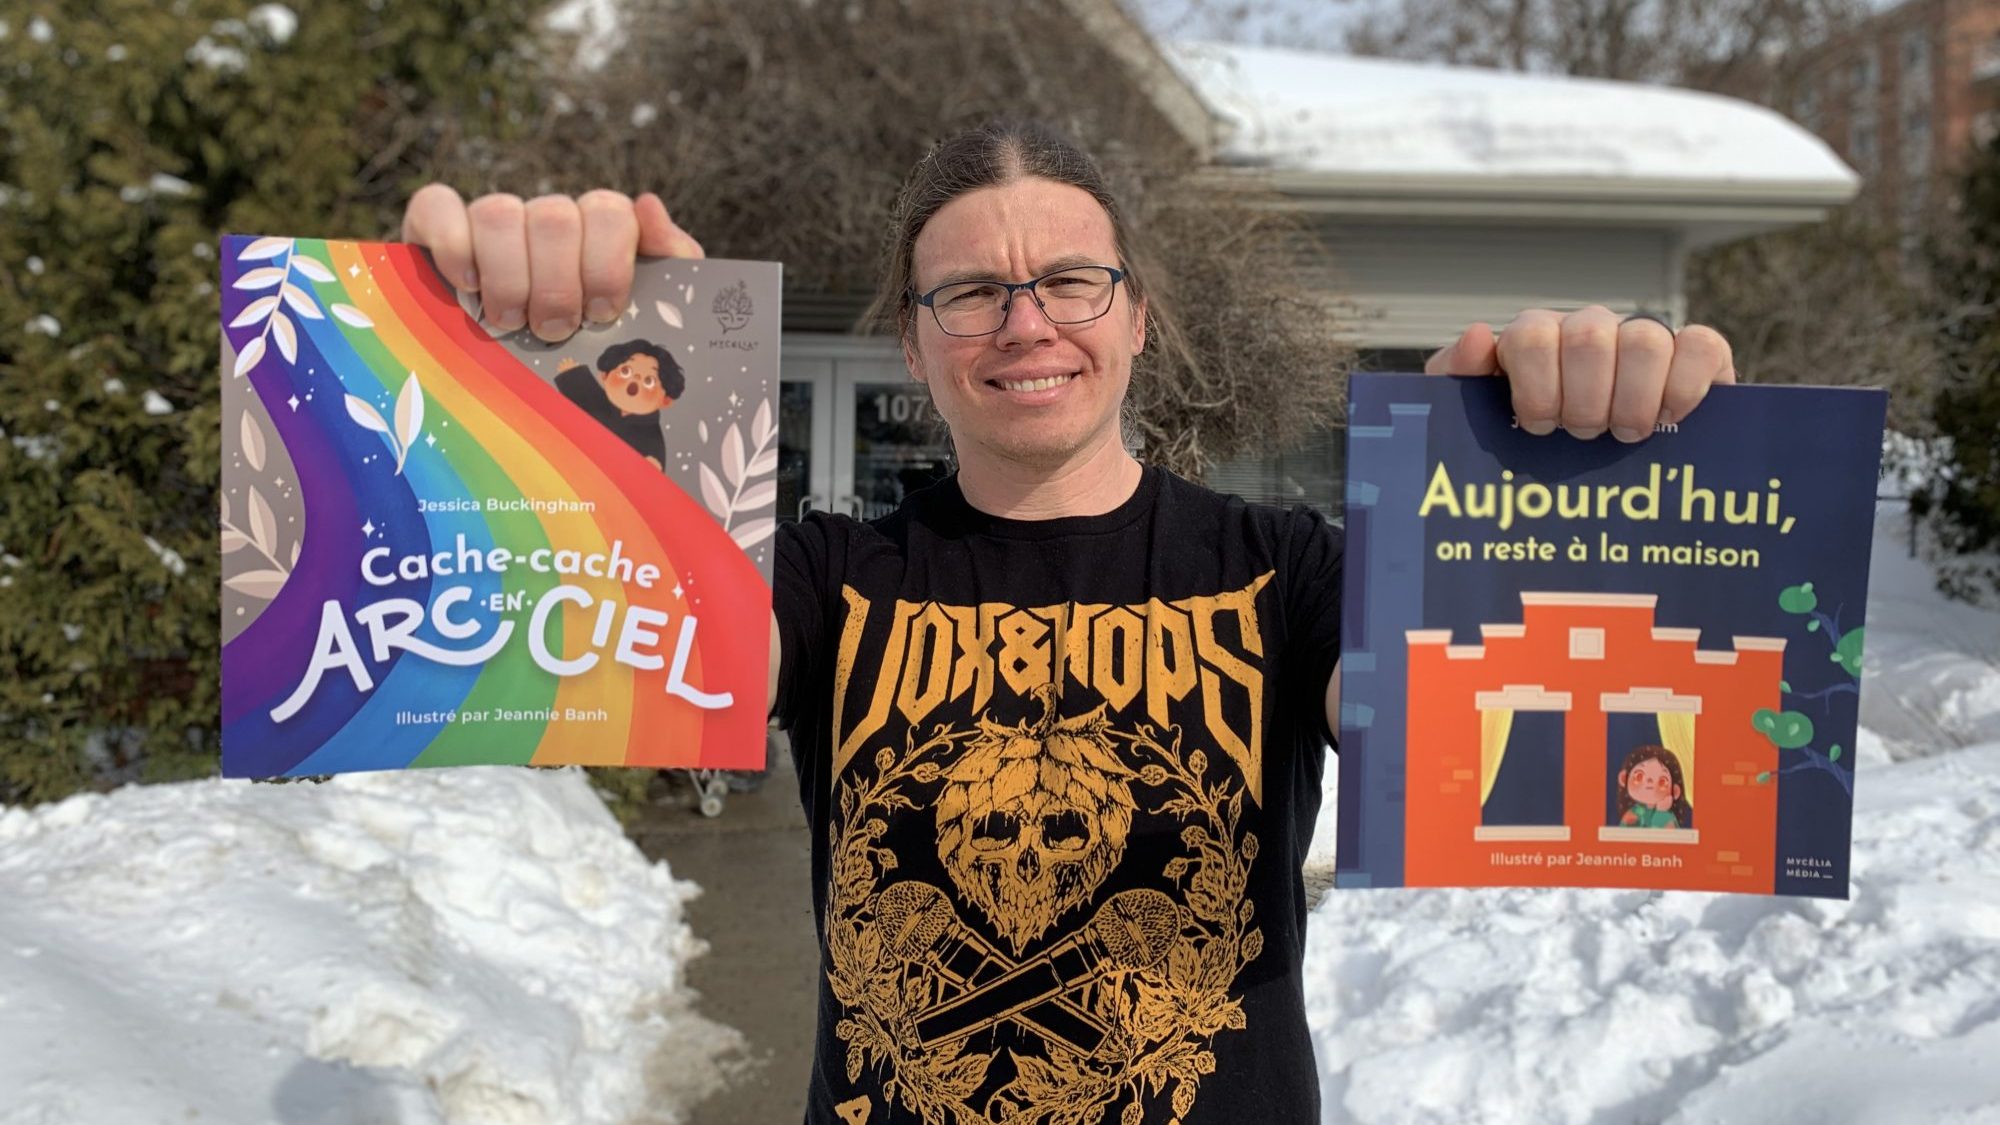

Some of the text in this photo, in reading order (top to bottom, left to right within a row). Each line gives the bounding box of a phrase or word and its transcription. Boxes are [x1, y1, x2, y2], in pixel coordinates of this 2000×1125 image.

[418, 498, 596, 513] Jessica Buckingham
[361, 533, 661, 588] Cache-cache
[1436, 533, 1760, 568] on reste à la maison
[270, 586, 515, 724] ARC
[528, 585, 734, 710] CIEL
[832, 569, 1276, 810] VOX&HOPS
[396, 707, 608, 725] Illustré par Jeannie Banh
[1491, 852, 1683, 868] Illustré par Jeannie Banh
